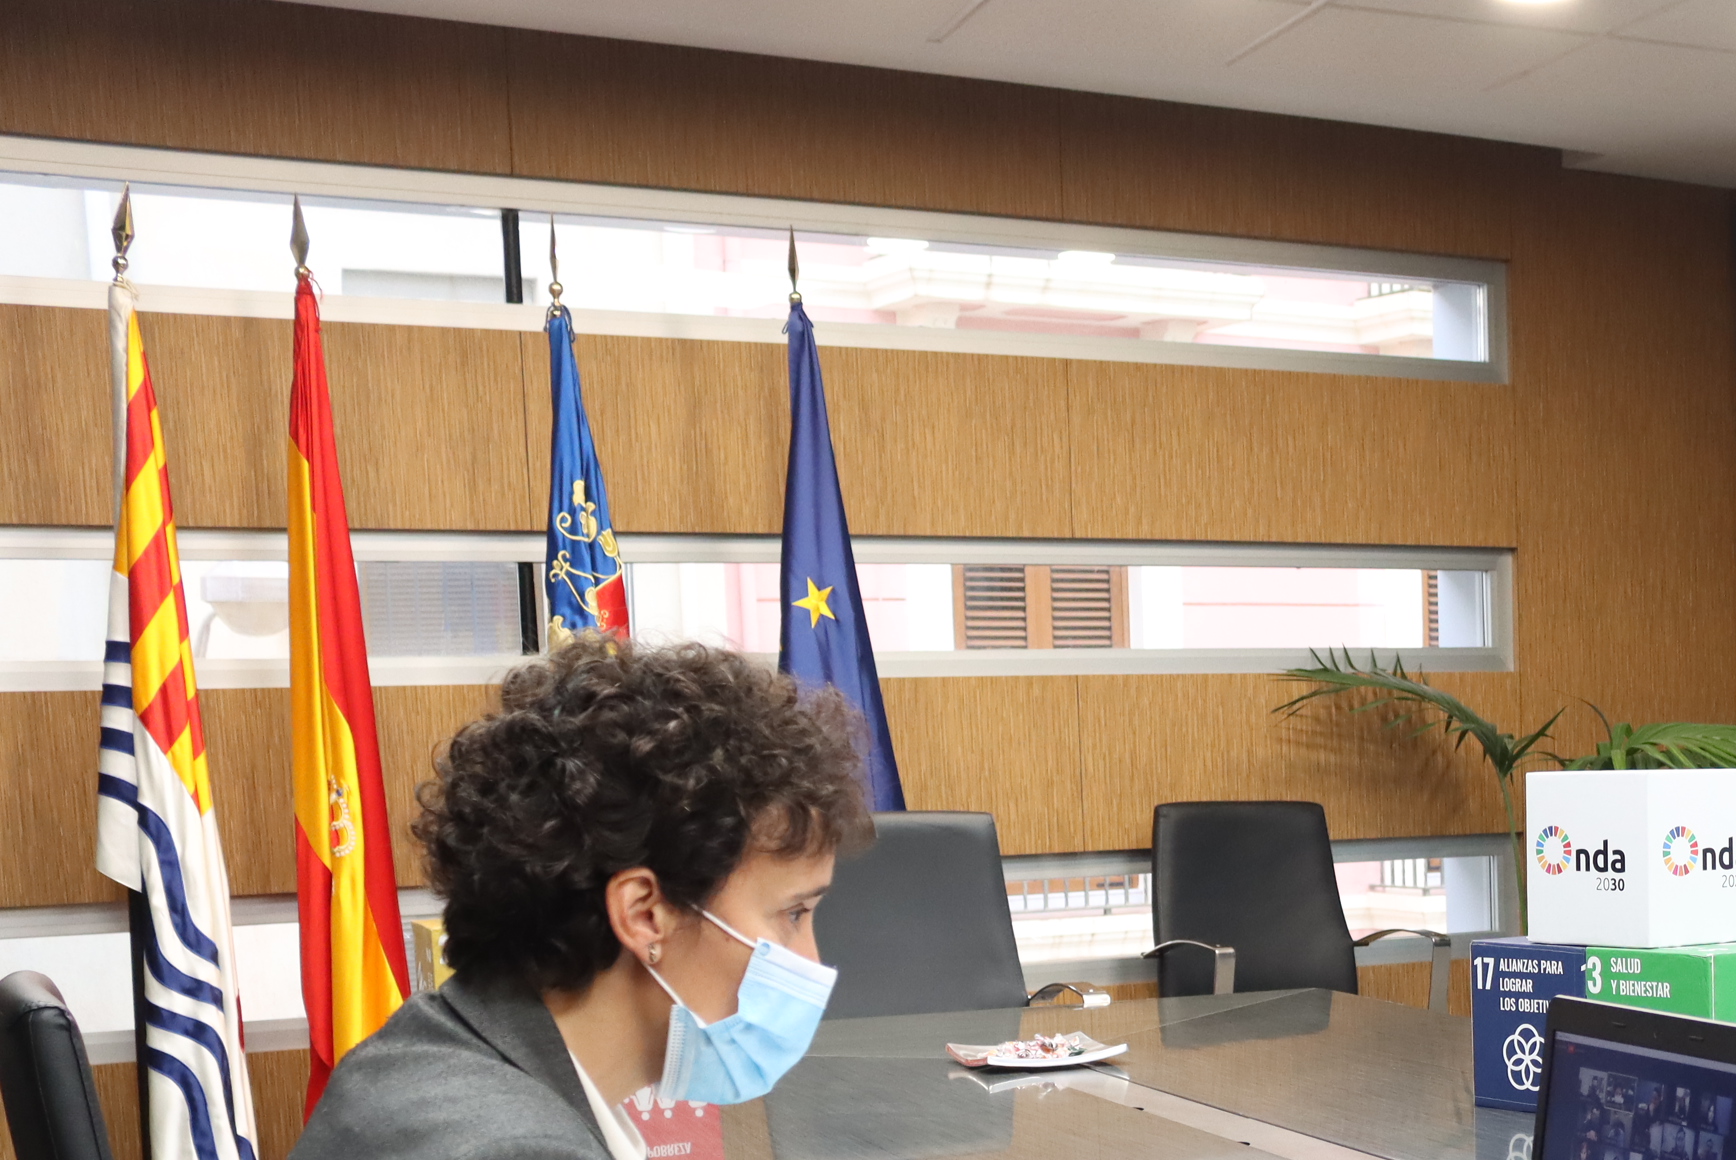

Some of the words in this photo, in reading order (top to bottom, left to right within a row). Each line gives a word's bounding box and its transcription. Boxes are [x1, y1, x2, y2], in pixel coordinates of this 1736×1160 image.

[1596, 877, 1625, 892] 2030
[1473, 956, 1495, 990] 17
[1499, 958, 1539, 974] ALIANZAS
[1540, 960, 1564, 975] PARA
[1610, 957, 1641, 974] SALUD
[1587, 956, 1602, 994] 3
[1499, 978, 1533, 993] LOGRAR
[1610, 979, 1618, 995] Y
[1619, 980, 1671, 998] BIENESTAR
[1500, 997, 1516, 1012] LOS
